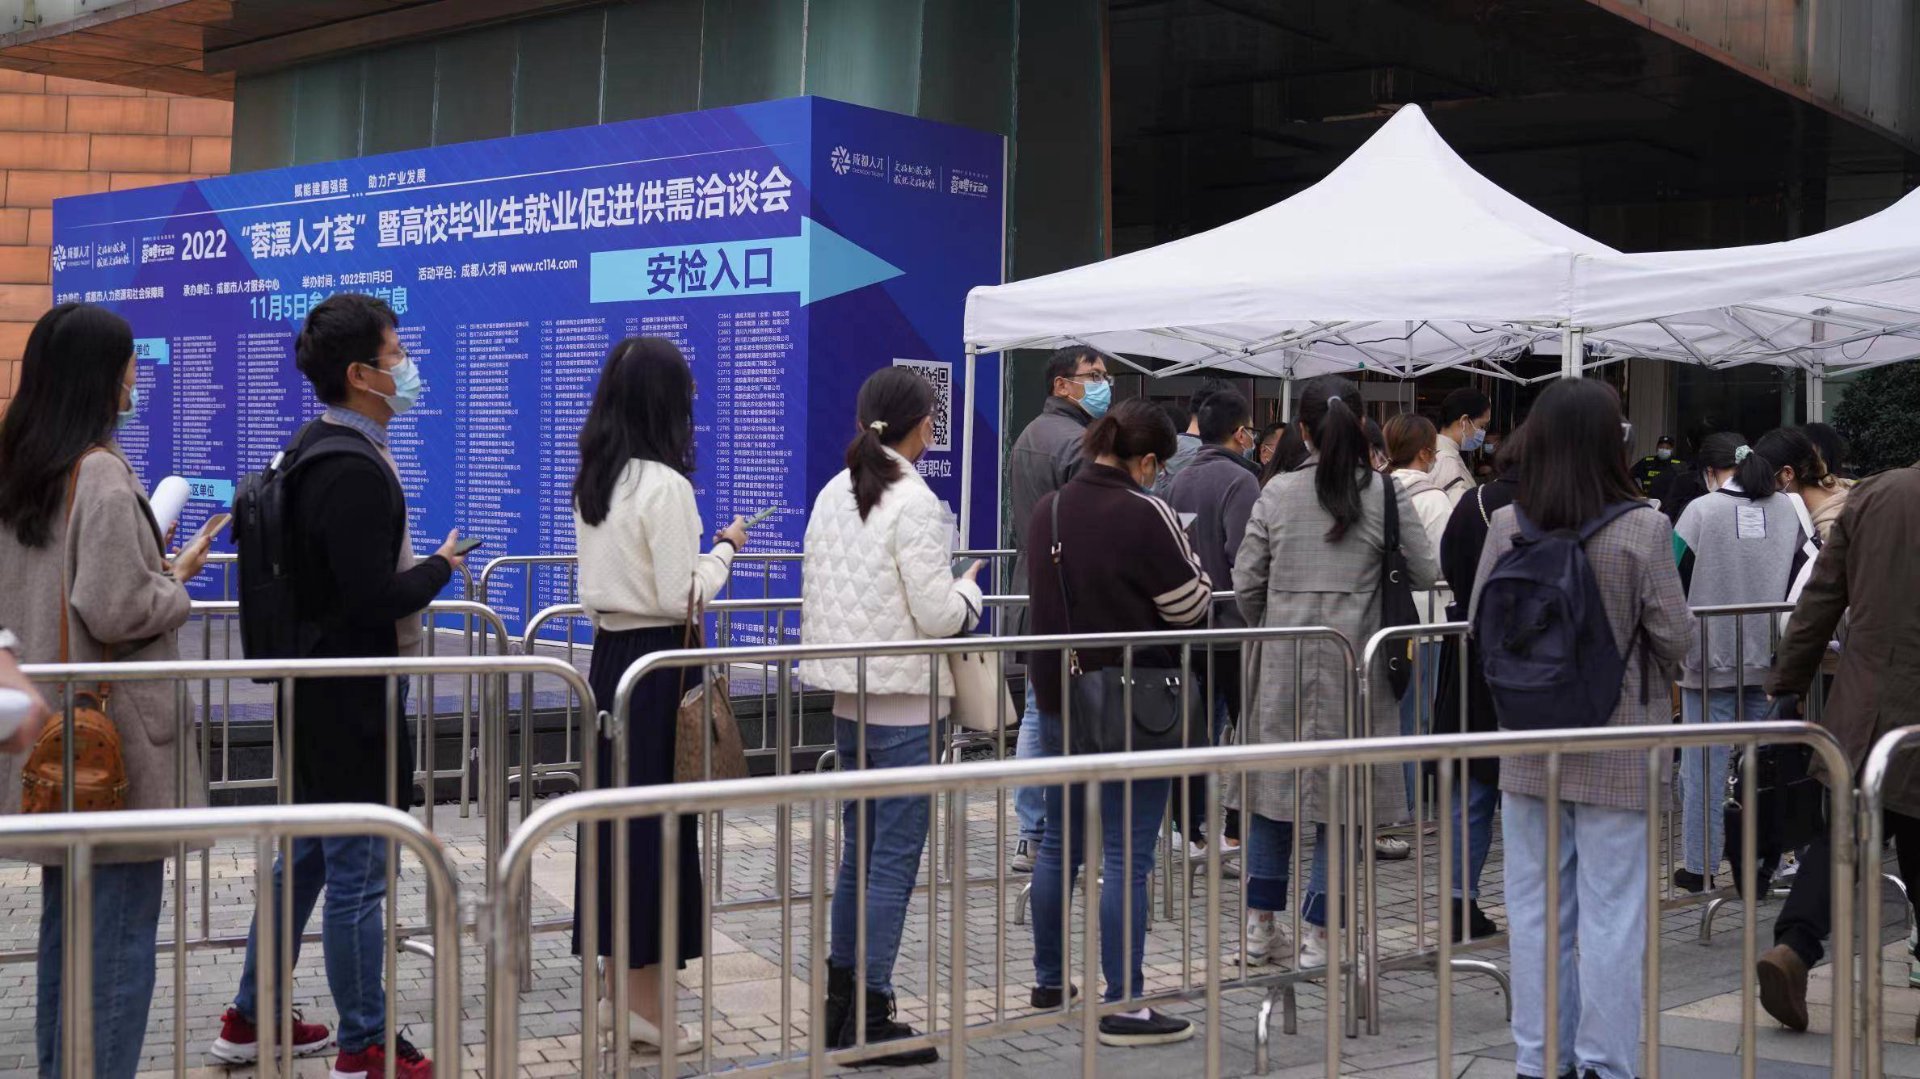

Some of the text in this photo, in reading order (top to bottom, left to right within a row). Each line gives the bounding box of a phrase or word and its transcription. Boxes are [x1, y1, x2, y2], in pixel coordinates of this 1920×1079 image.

[294, 168, 427, 198] 赋能建圈强链 助力产业发展
[181, 229, 227, 261] 2022
[377, 166, 792, 248] 暨高校毕业生就业促进供需洽谈会
[511, 258, 578, 274] www.rc114.com
[646, 247, 774, 296] 安检入口
[912, 459, 952, 478] 查职位
